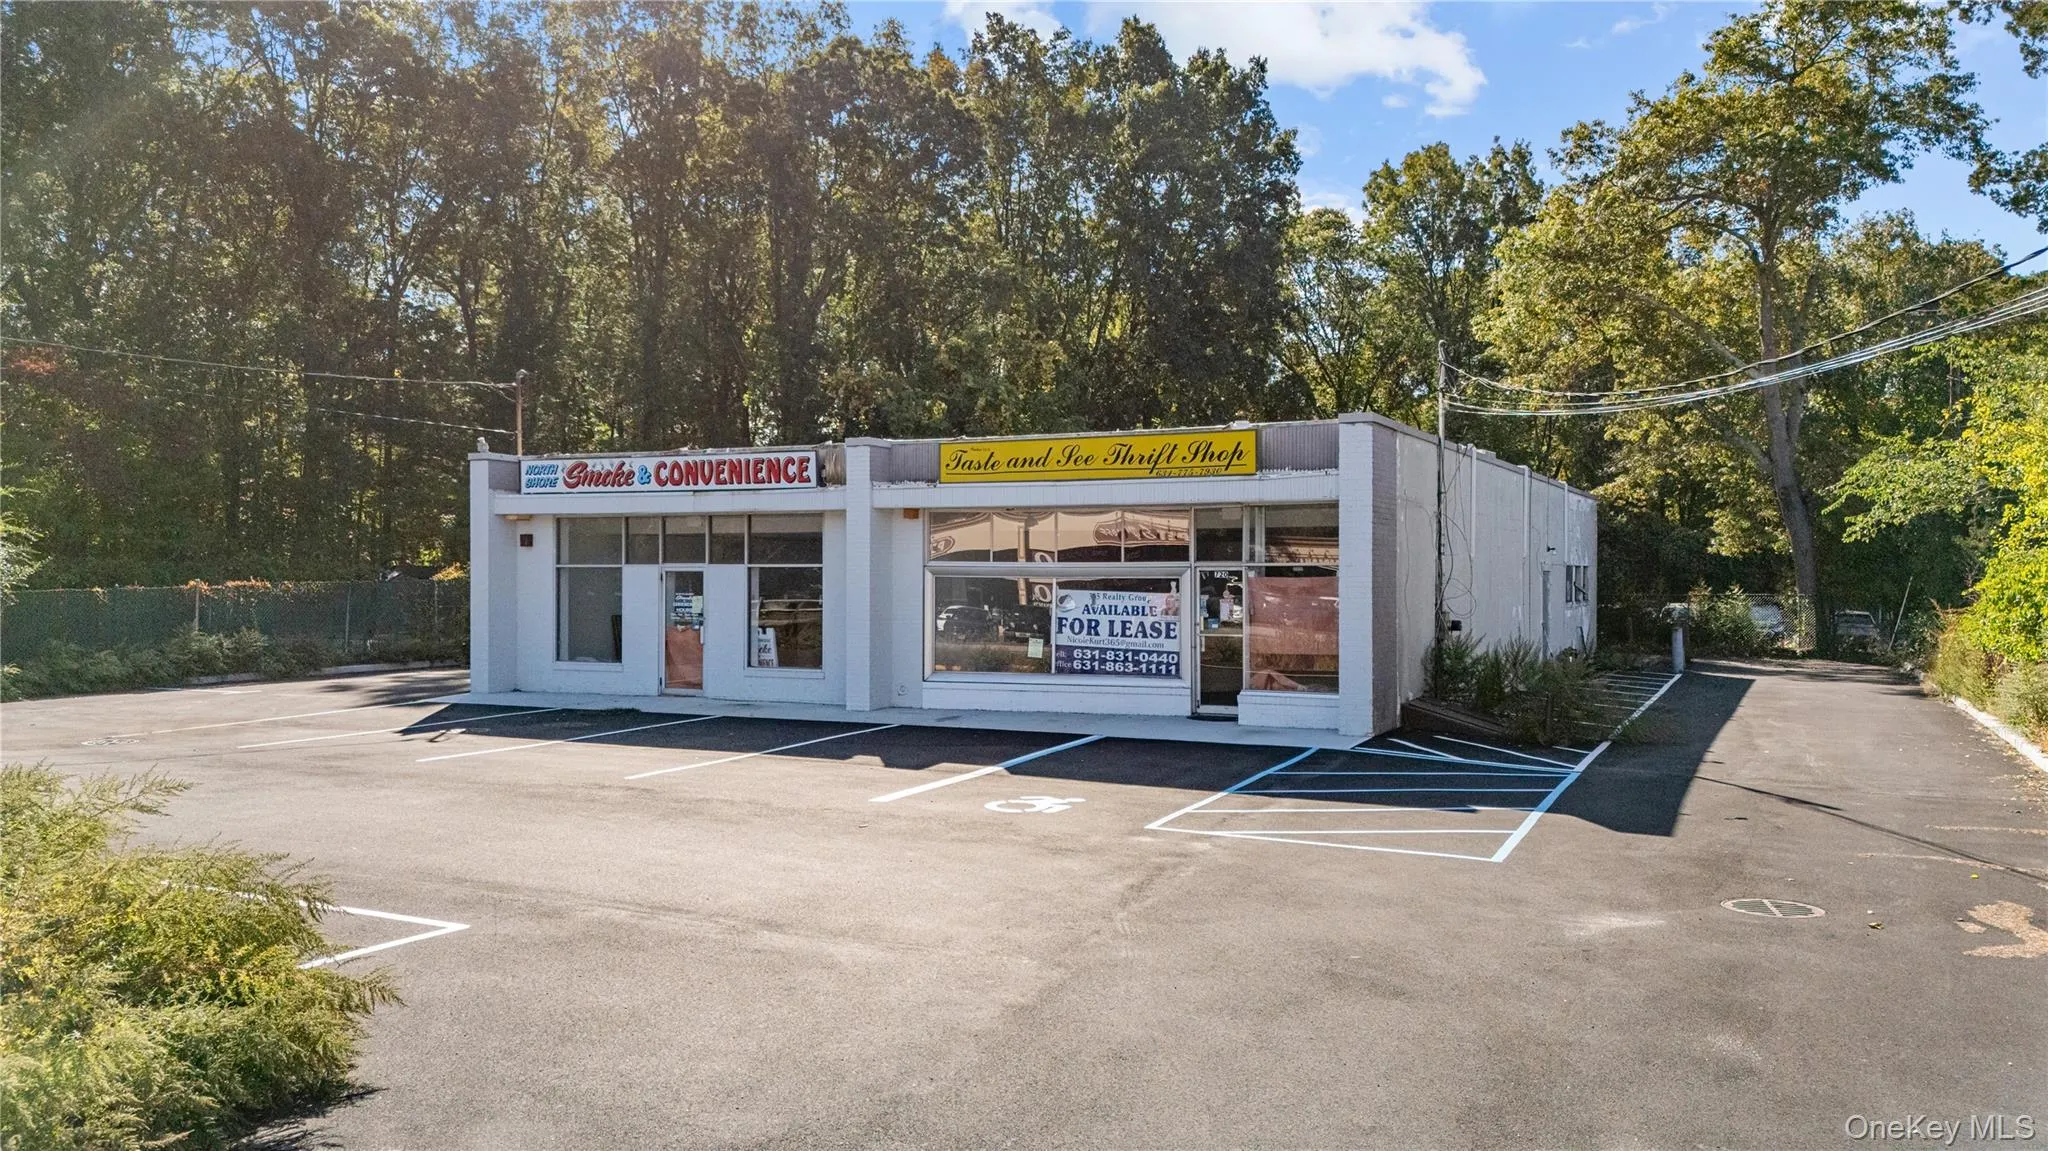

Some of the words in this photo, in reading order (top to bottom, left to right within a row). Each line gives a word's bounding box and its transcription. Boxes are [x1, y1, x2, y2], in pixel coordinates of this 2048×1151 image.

[945, 447, 1003, 471] Taste
[1006, 446, 1054, 468] and
[1056, 444, 1097, 466] See
[1103, 441, 1179, 474] Thrift
[1181, 439, 1250, 471] Shop
[525, 463, 559, 476] NORTH
[562, 459, 636, 489] Smoke
[636, 465, 652, 485] &
[653, 455, 812, 487] CONVENIENCE
[525, 477, 559, 489] SHORE
[1102, 593, 1126, 602] Realty
[1081, 604, 1158, 617] AVAILABLE
[1056, 617, 1101, 636] FOR
[1108, 619, 1178, 640] LEASE
[1073, 648, 1178, 664] 631-831-0440
[1073, 659, 1177, 675] 631-863-1111
